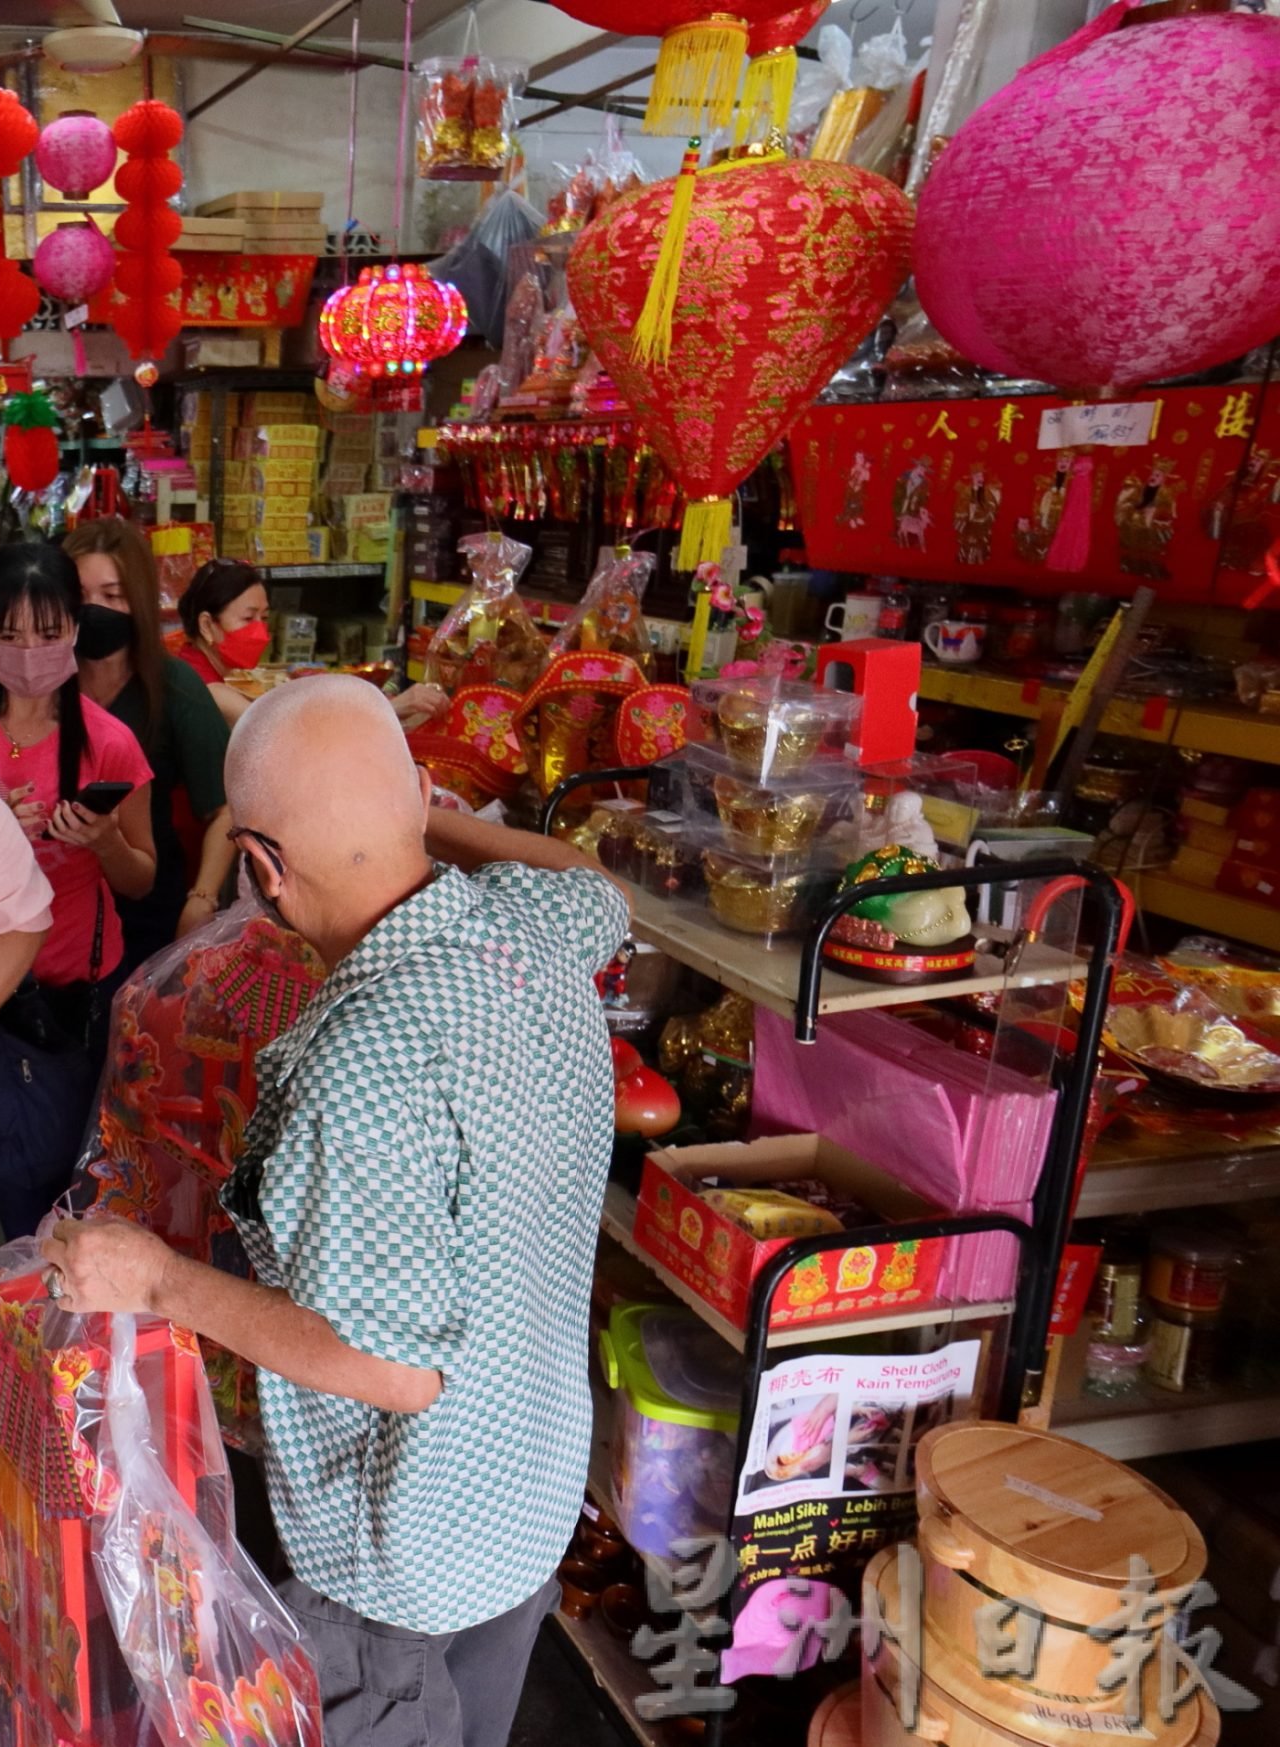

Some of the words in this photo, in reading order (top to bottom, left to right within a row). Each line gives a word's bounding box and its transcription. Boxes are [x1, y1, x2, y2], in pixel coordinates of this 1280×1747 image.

[856, 1379, 890, 1389] Kain
[895, 1366, 961, 1389] Tempurung
[881, 1366, 917, 1377] Shell
[922, 1358, 948, 1375] Cloth
[754, 1507, 795, 1530] Mahal
[796, 1502, 829, 1519] Sikit
[846, 1500, 887, 1514] Lebih
